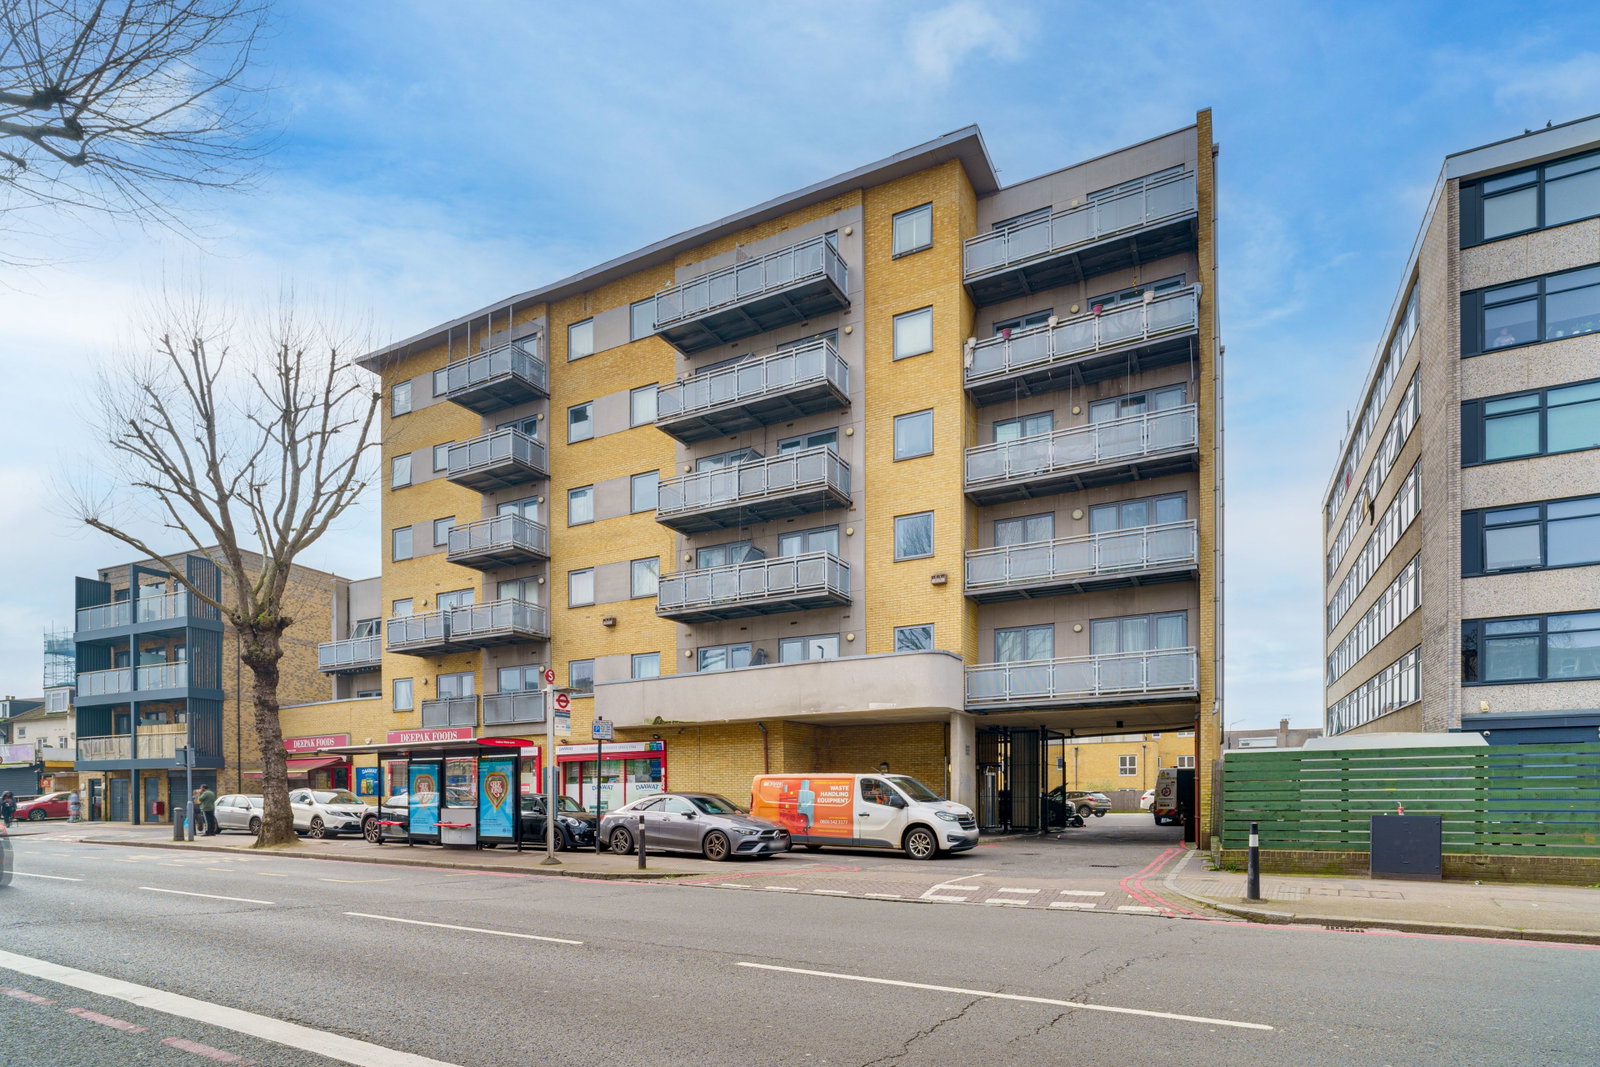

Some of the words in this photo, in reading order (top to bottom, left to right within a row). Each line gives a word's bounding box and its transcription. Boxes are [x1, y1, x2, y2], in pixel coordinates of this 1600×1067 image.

[548, 671, 553, 680] S
[400, 732, 430, 742] DEEPAK
[432, 731, 458, 740] FOODS
[294, 739, 315, 748] DEEPAK
[316, 738, 334, 746] FOODS
